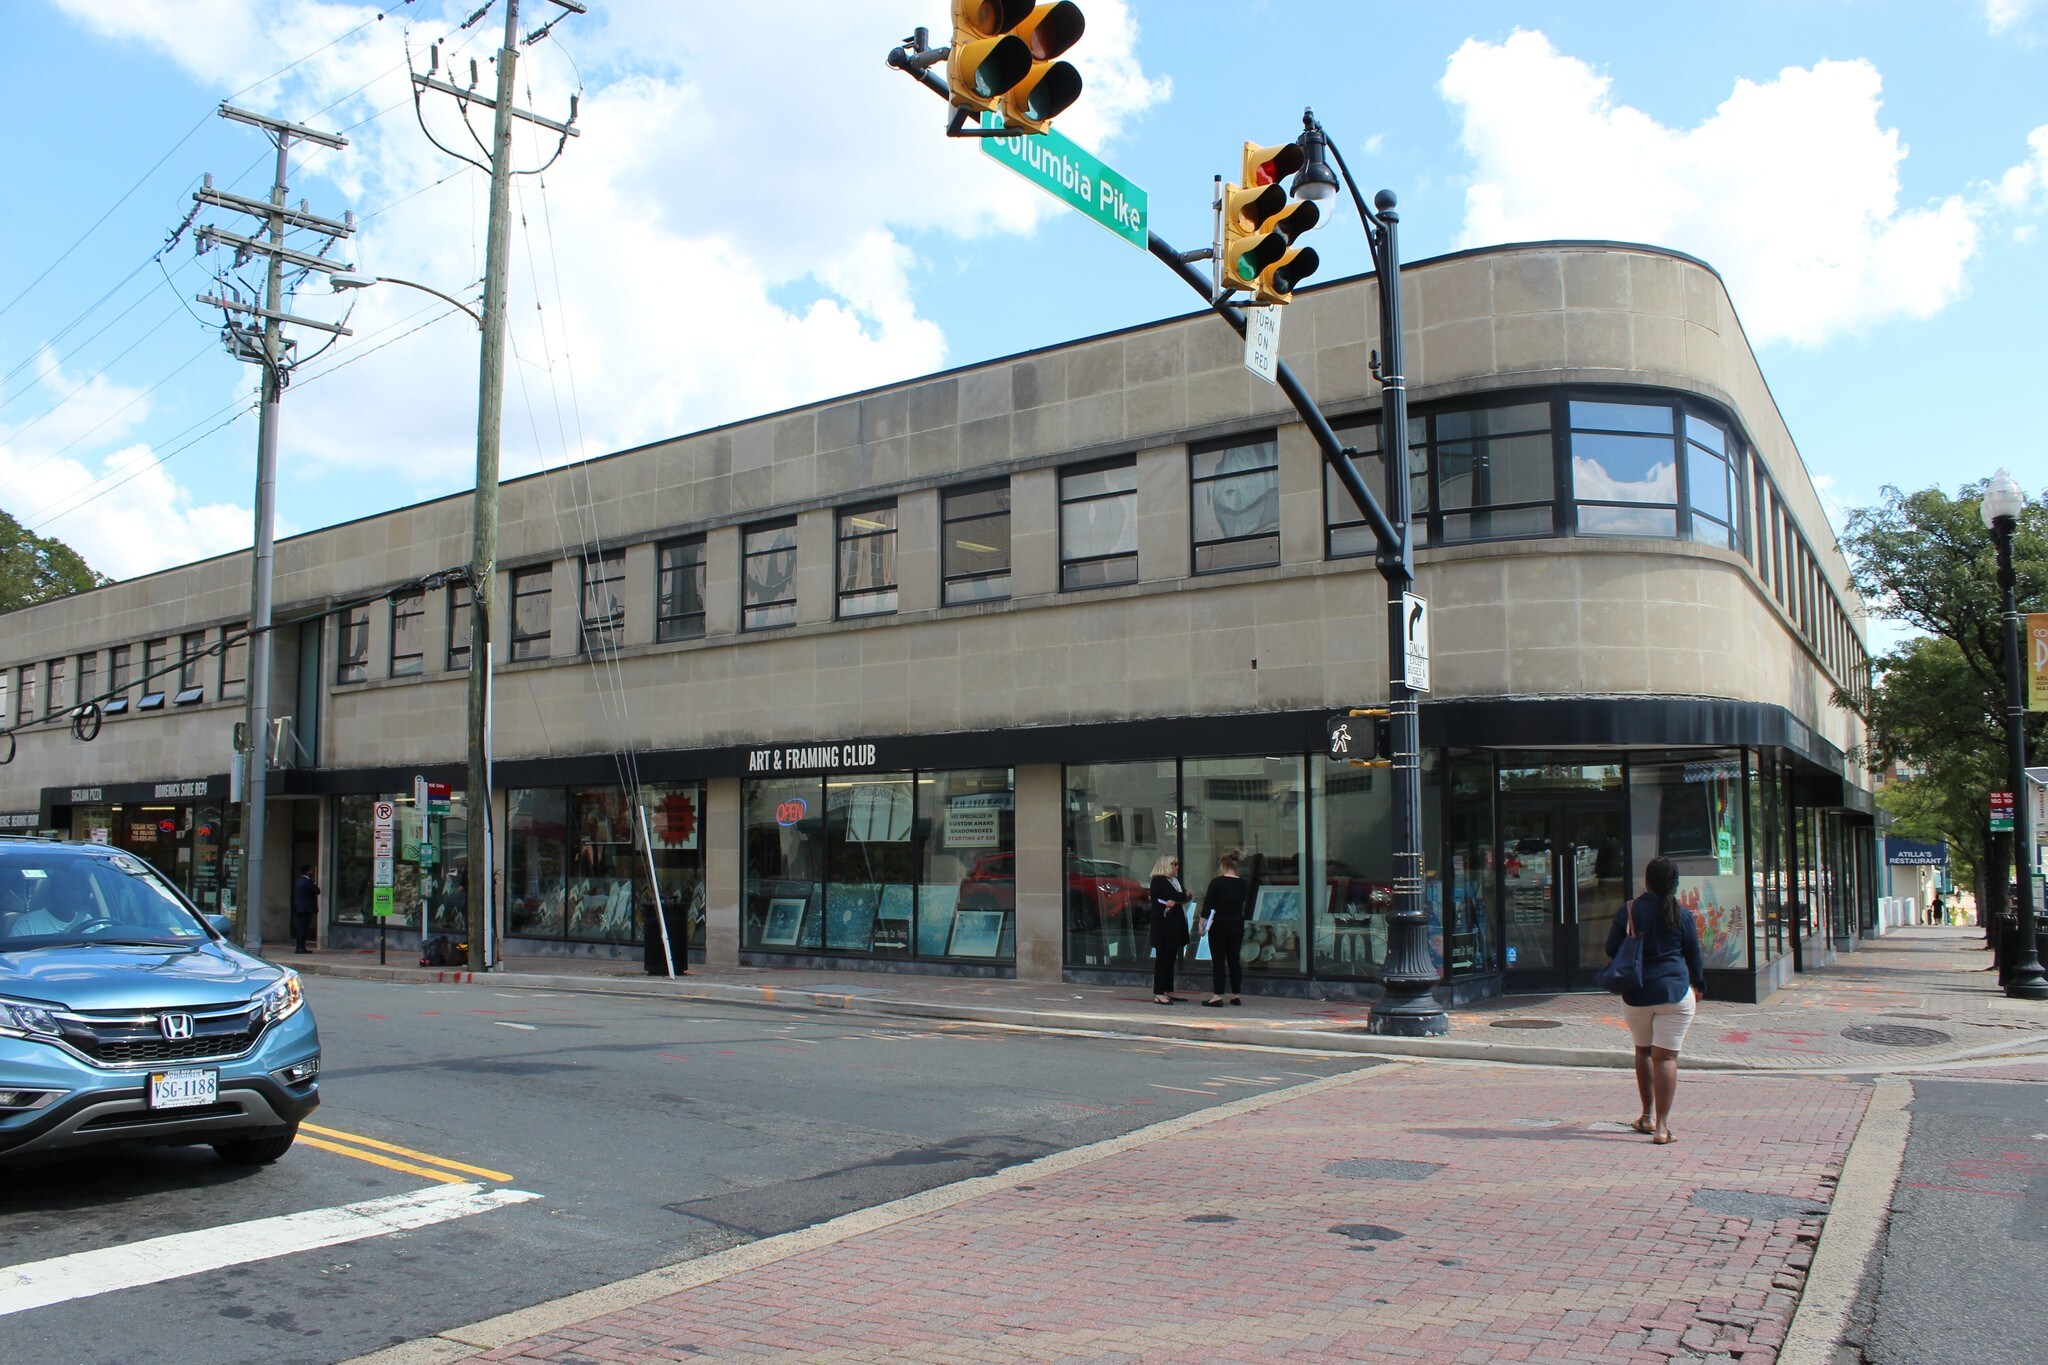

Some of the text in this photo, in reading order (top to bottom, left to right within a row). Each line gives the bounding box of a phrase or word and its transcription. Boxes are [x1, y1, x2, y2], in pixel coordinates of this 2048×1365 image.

[991, 109, 1140, 232] Columbia Pike
[1256, 310, 1274, 334] TURN
[1257, 333, 1269, 351] ON
[1254, 351, 1268, 371] RED
[1409, 642, 1424, 658] ONLY
[1408, 665, 1421, 677] BUSES
[749, 744, 876, 771] ART & FRAMING CLUB
[1541, 765, 1584, 780] 2811
[90, 787, 102, 801] PIZZA
[181, 783, 194, 797] SHOE
[776, 802, 804, 821] OPEN
[155, 1078, 215, 1099] VSG-1188
